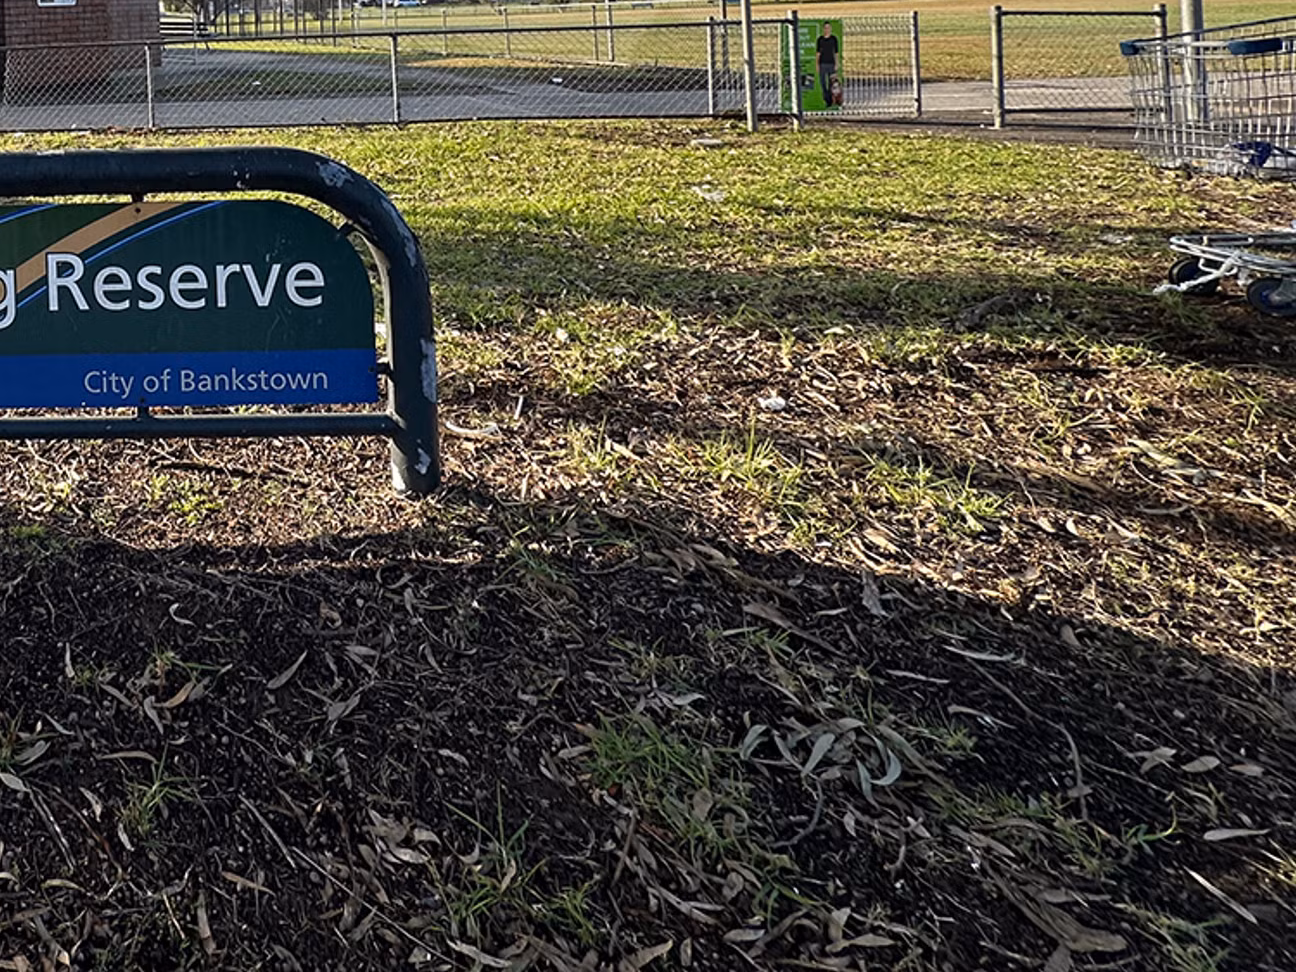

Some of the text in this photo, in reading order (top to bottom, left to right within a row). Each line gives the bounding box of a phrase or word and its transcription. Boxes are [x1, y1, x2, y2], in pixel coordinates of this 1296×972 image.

[46, 252, 326, 312] Reserve
[83, 368, 329, 399] City of Bankstown
